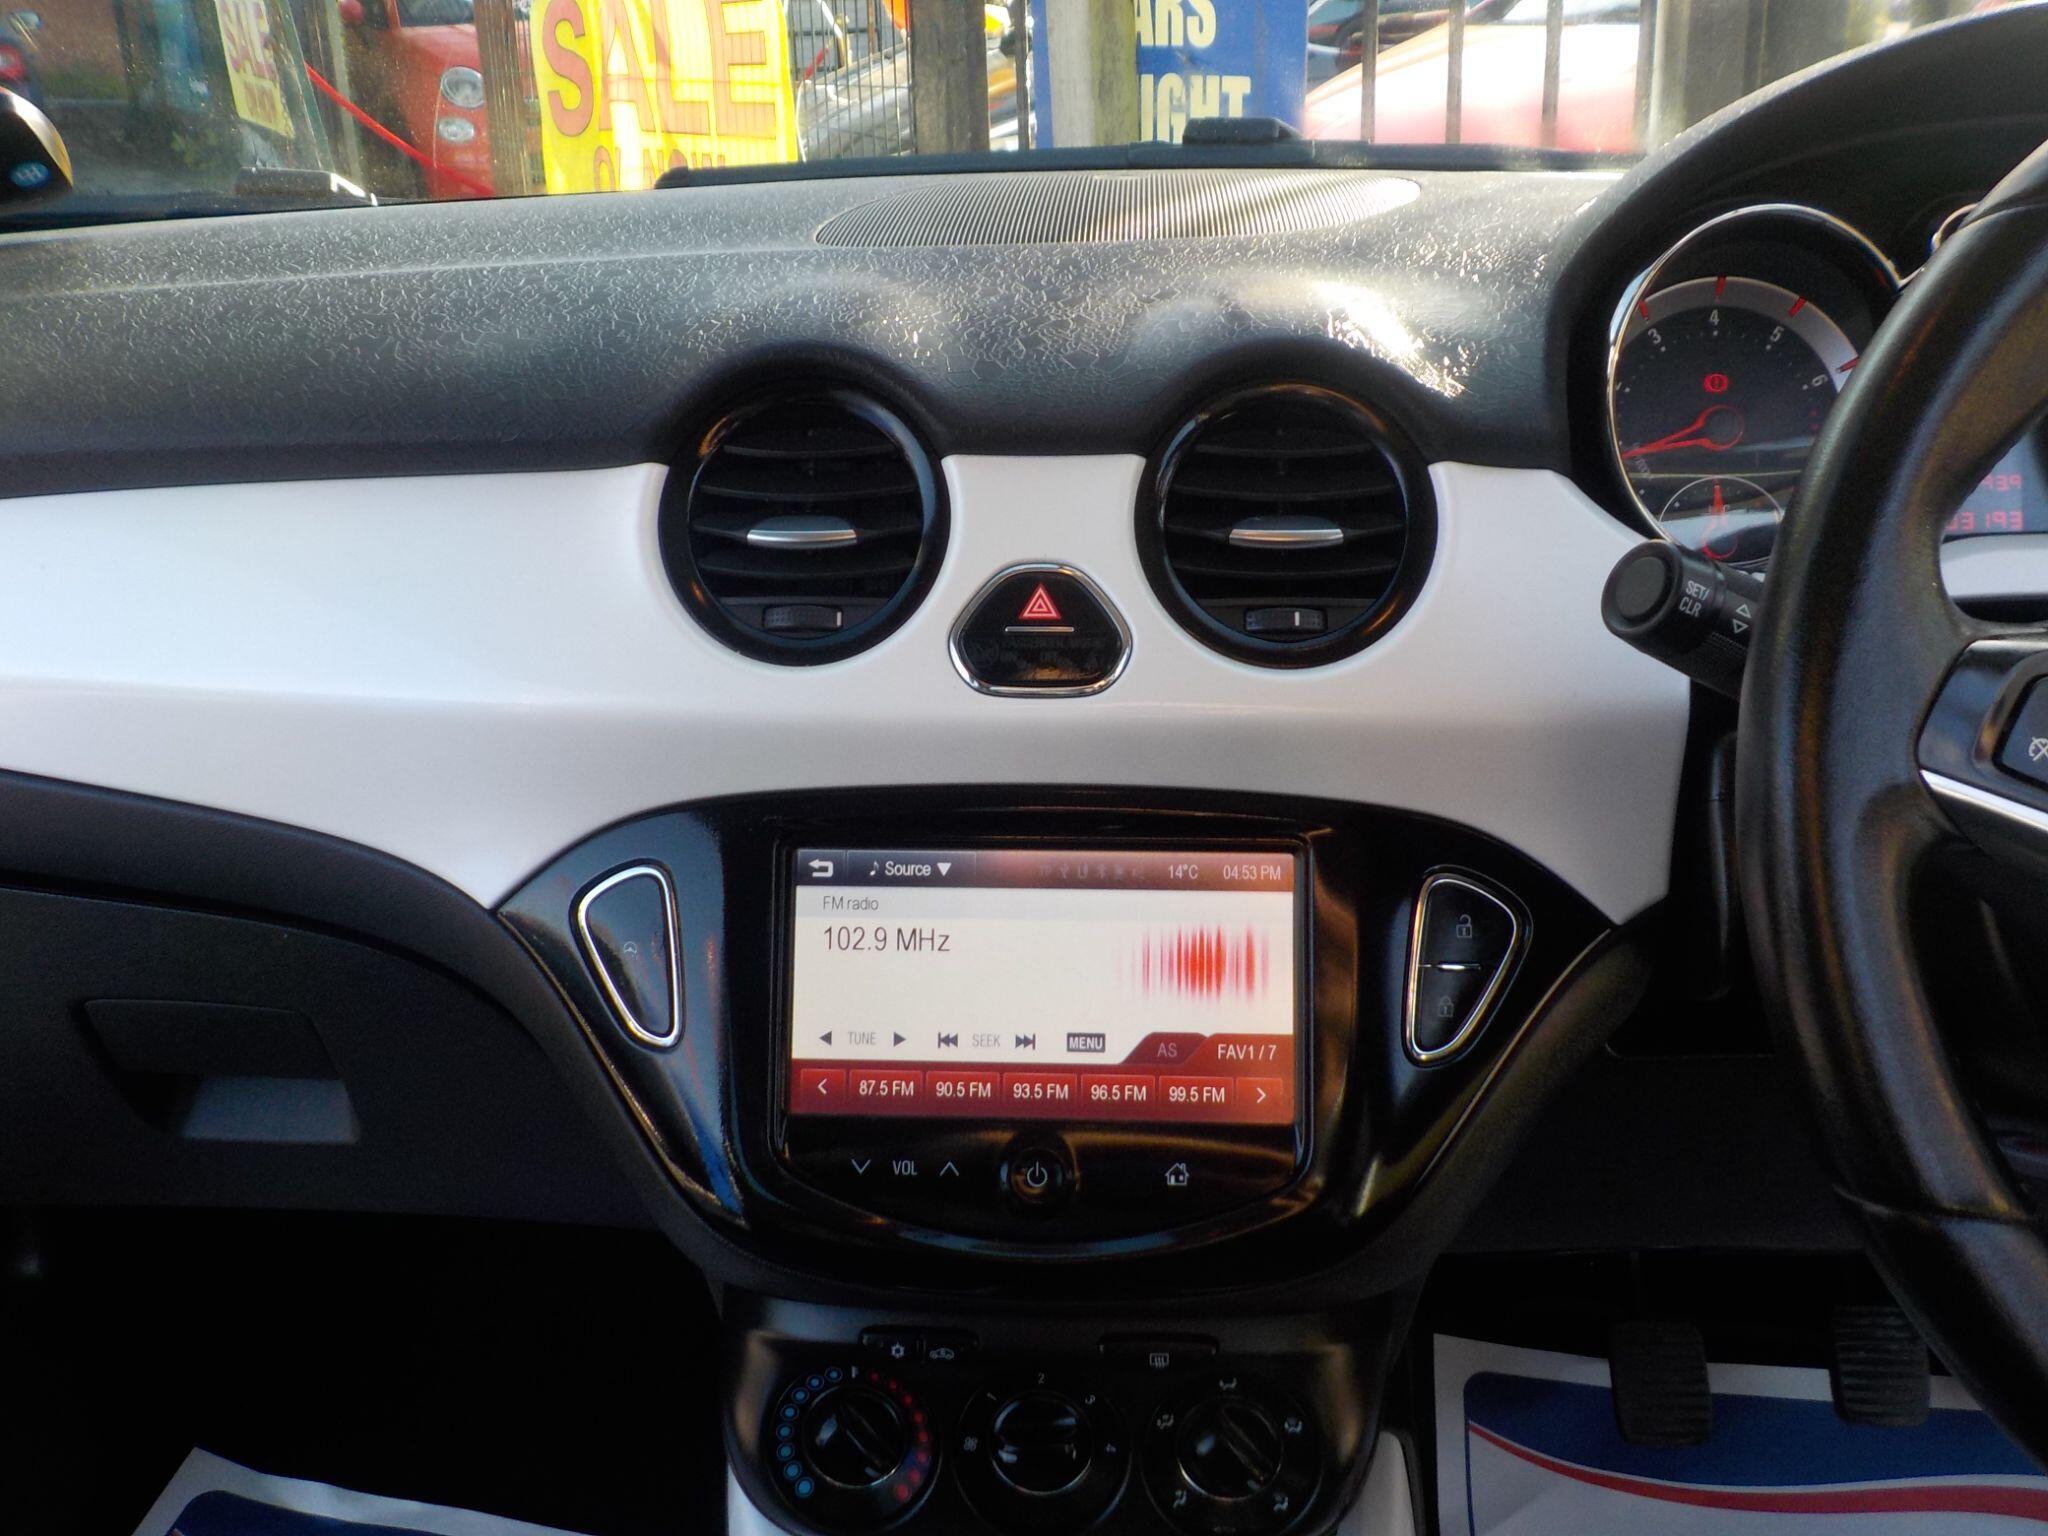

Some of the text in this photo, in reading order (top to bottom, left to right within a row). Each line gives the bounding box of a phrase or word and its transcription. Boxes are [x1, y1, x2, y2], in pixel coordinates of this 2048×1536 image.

[542, 0, 777, 139] SALE
[1709, 309, 1720, 325] 4
[1647, 328, 1662, 344] 3
[1769, 325, 1785, 342] 5
[1679, 596, 1702, 618] CLR
[884, 860, 932, 877] Source
[1168, 864, 1199, 880] 14°C
[1223, 864, 1281, 881] 04:53 PM
[822, 895, 879, 911] FM radio
[823, 926, 951, 952] 102.9 MHz
[848, 1031, 877, 1046] TUNE
[972, 1033, 1001, 1048] SEEK
[1068, 1036, 1104, 1051] MENU
[1157, 1042, 1178, 1058] AS
[858, 1080, 914, 1097] 87.5 FM
[935, 1081, 991, 1098] 90.5 FM
[1013, 1083, 1069, 1100] 93.5 FM
[1090, 1084, 1147, 1101] 96.5 FM
[1169, 1086, 1225, 1102] 99.5 FM
[892, 1159, 918, 1176] VOL
